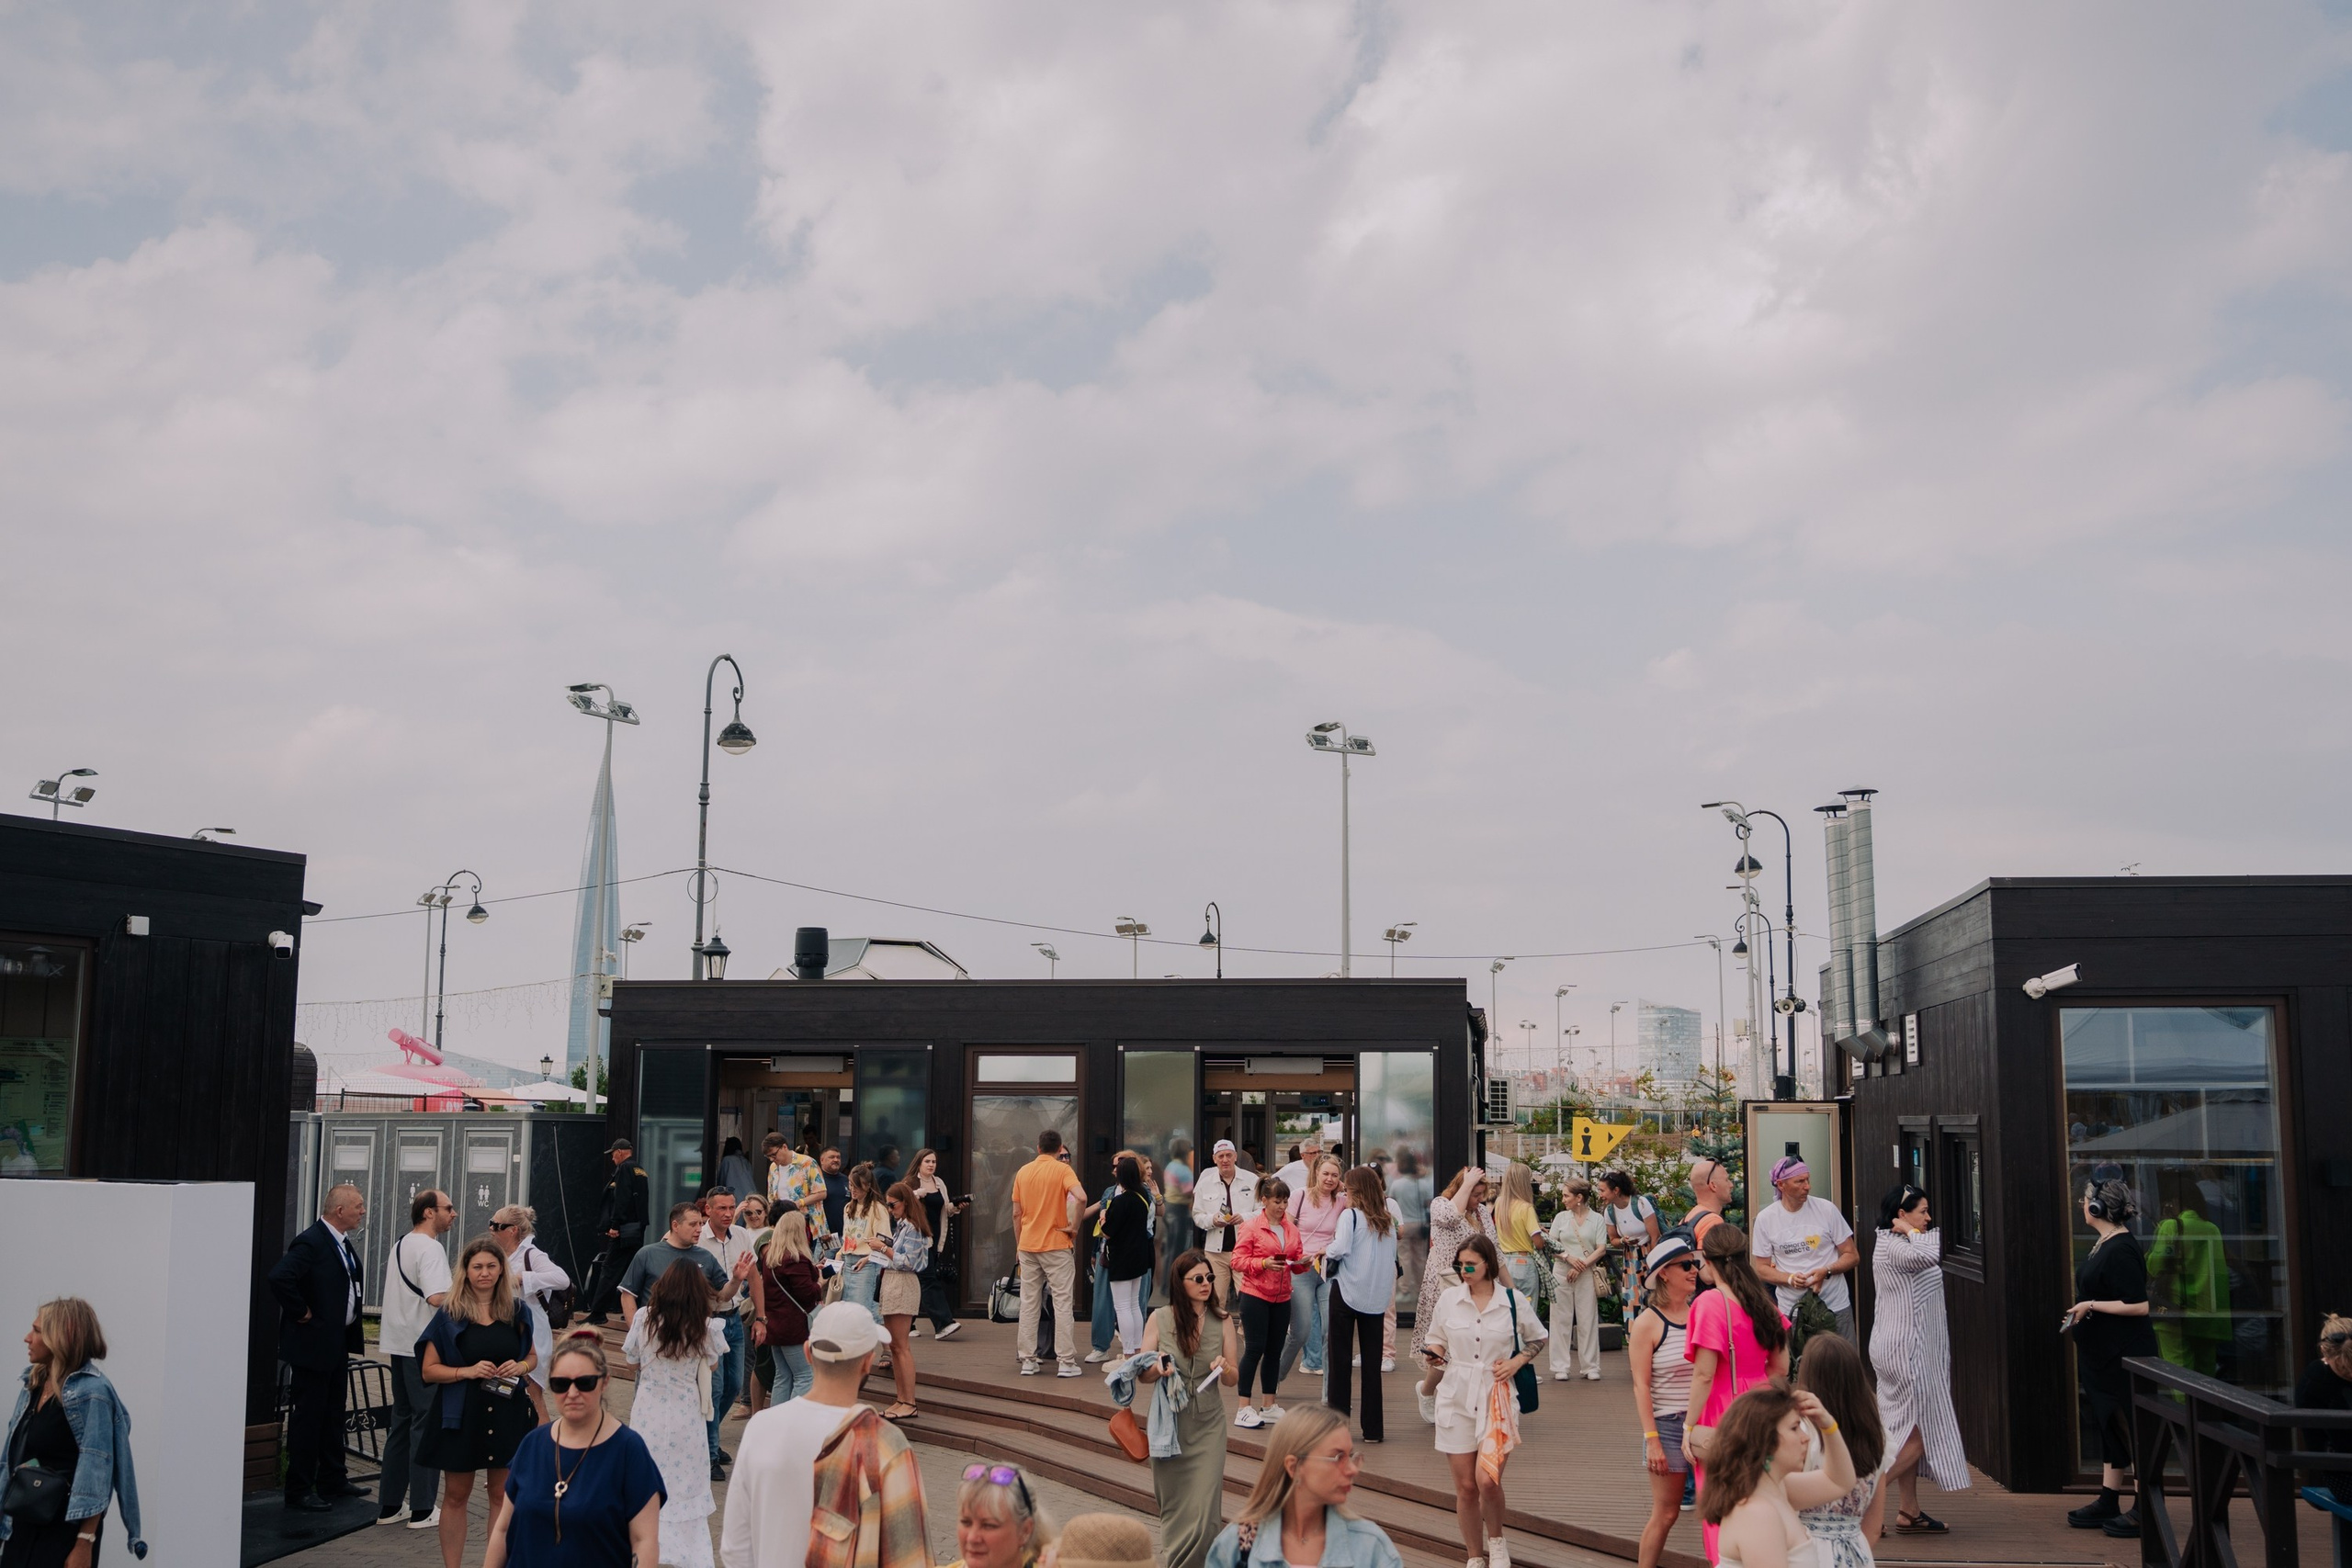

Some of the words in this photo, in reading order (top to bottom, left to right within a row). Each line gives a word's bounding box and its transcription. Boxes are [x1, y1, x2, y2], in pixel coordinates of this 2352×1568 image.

[477, 1200, 490, 1208] WC
[1779, 1239, 1815, 1250] помогаем
[1784, 1246, 1810, 1255] вместе
